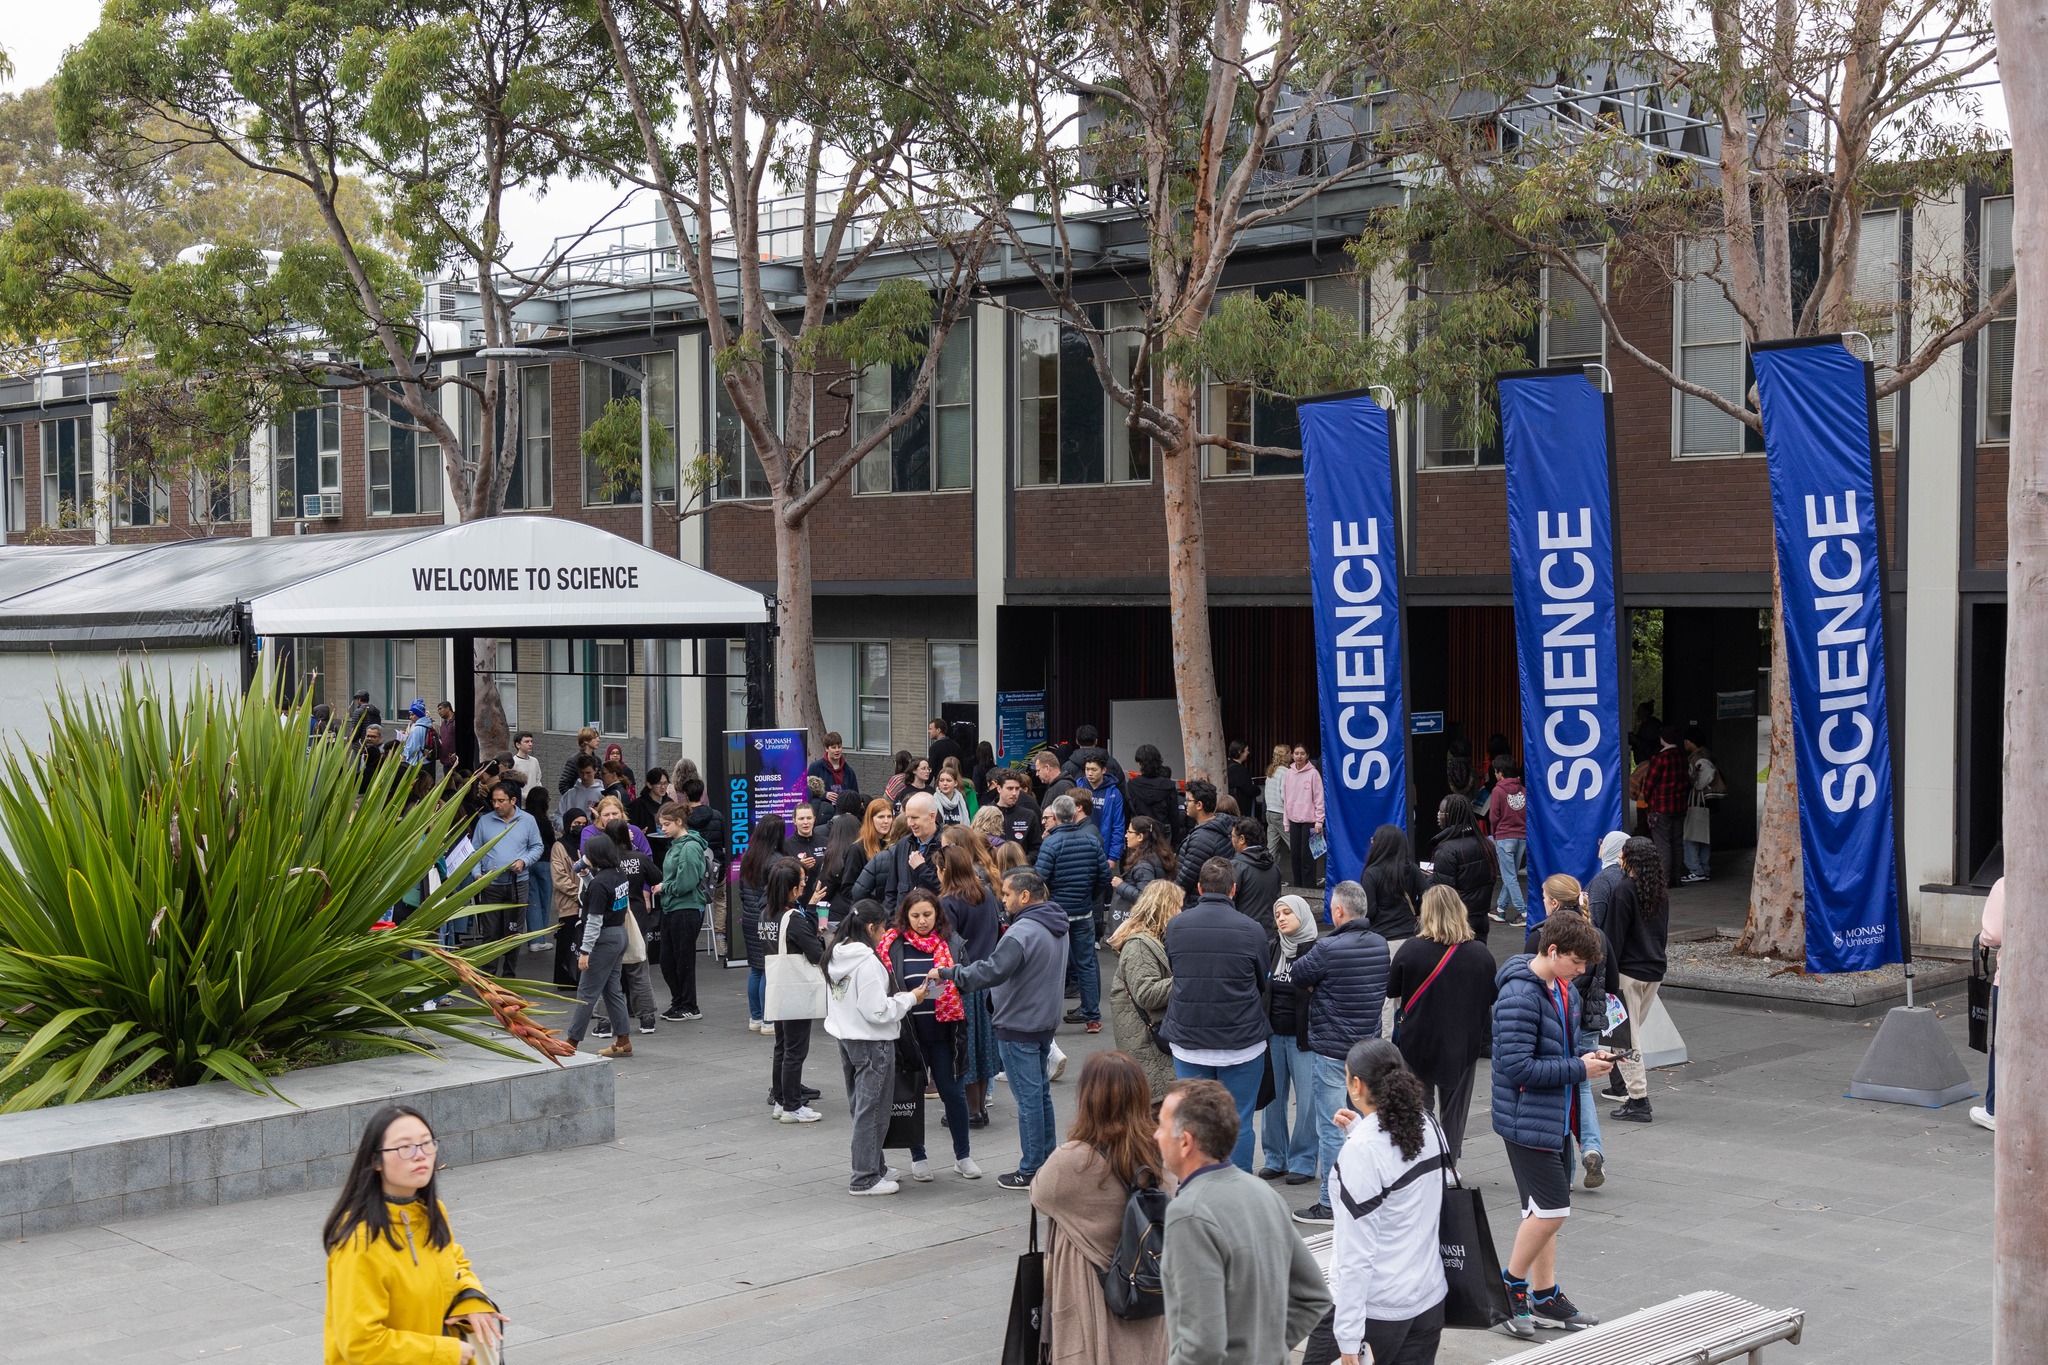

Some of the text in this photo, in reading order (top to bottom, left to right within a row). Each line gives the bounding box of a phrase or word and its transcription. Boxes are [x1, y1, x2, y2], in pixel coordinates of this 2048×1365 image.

[412, 566, 639, 591] WELCOME TO SCIENCE
[1332, 517, 1391, 790] SCIENCE
[1537, 507, 1603, 801] SCIENCE
[1804, 490, 1877, 813] SCIENCE
[754, 774, 782, 782] COURSES
[730, 778, 749, 855] SCIENCE
[620, 858, 640, 868] NASH
[757, 921, 779, 931] MNASH
[891, 1102, 916, 1110] ONASH
[1440, 1244, 1466, 1257] NASH
[1444, 1257, 1464, 1271] ersity
